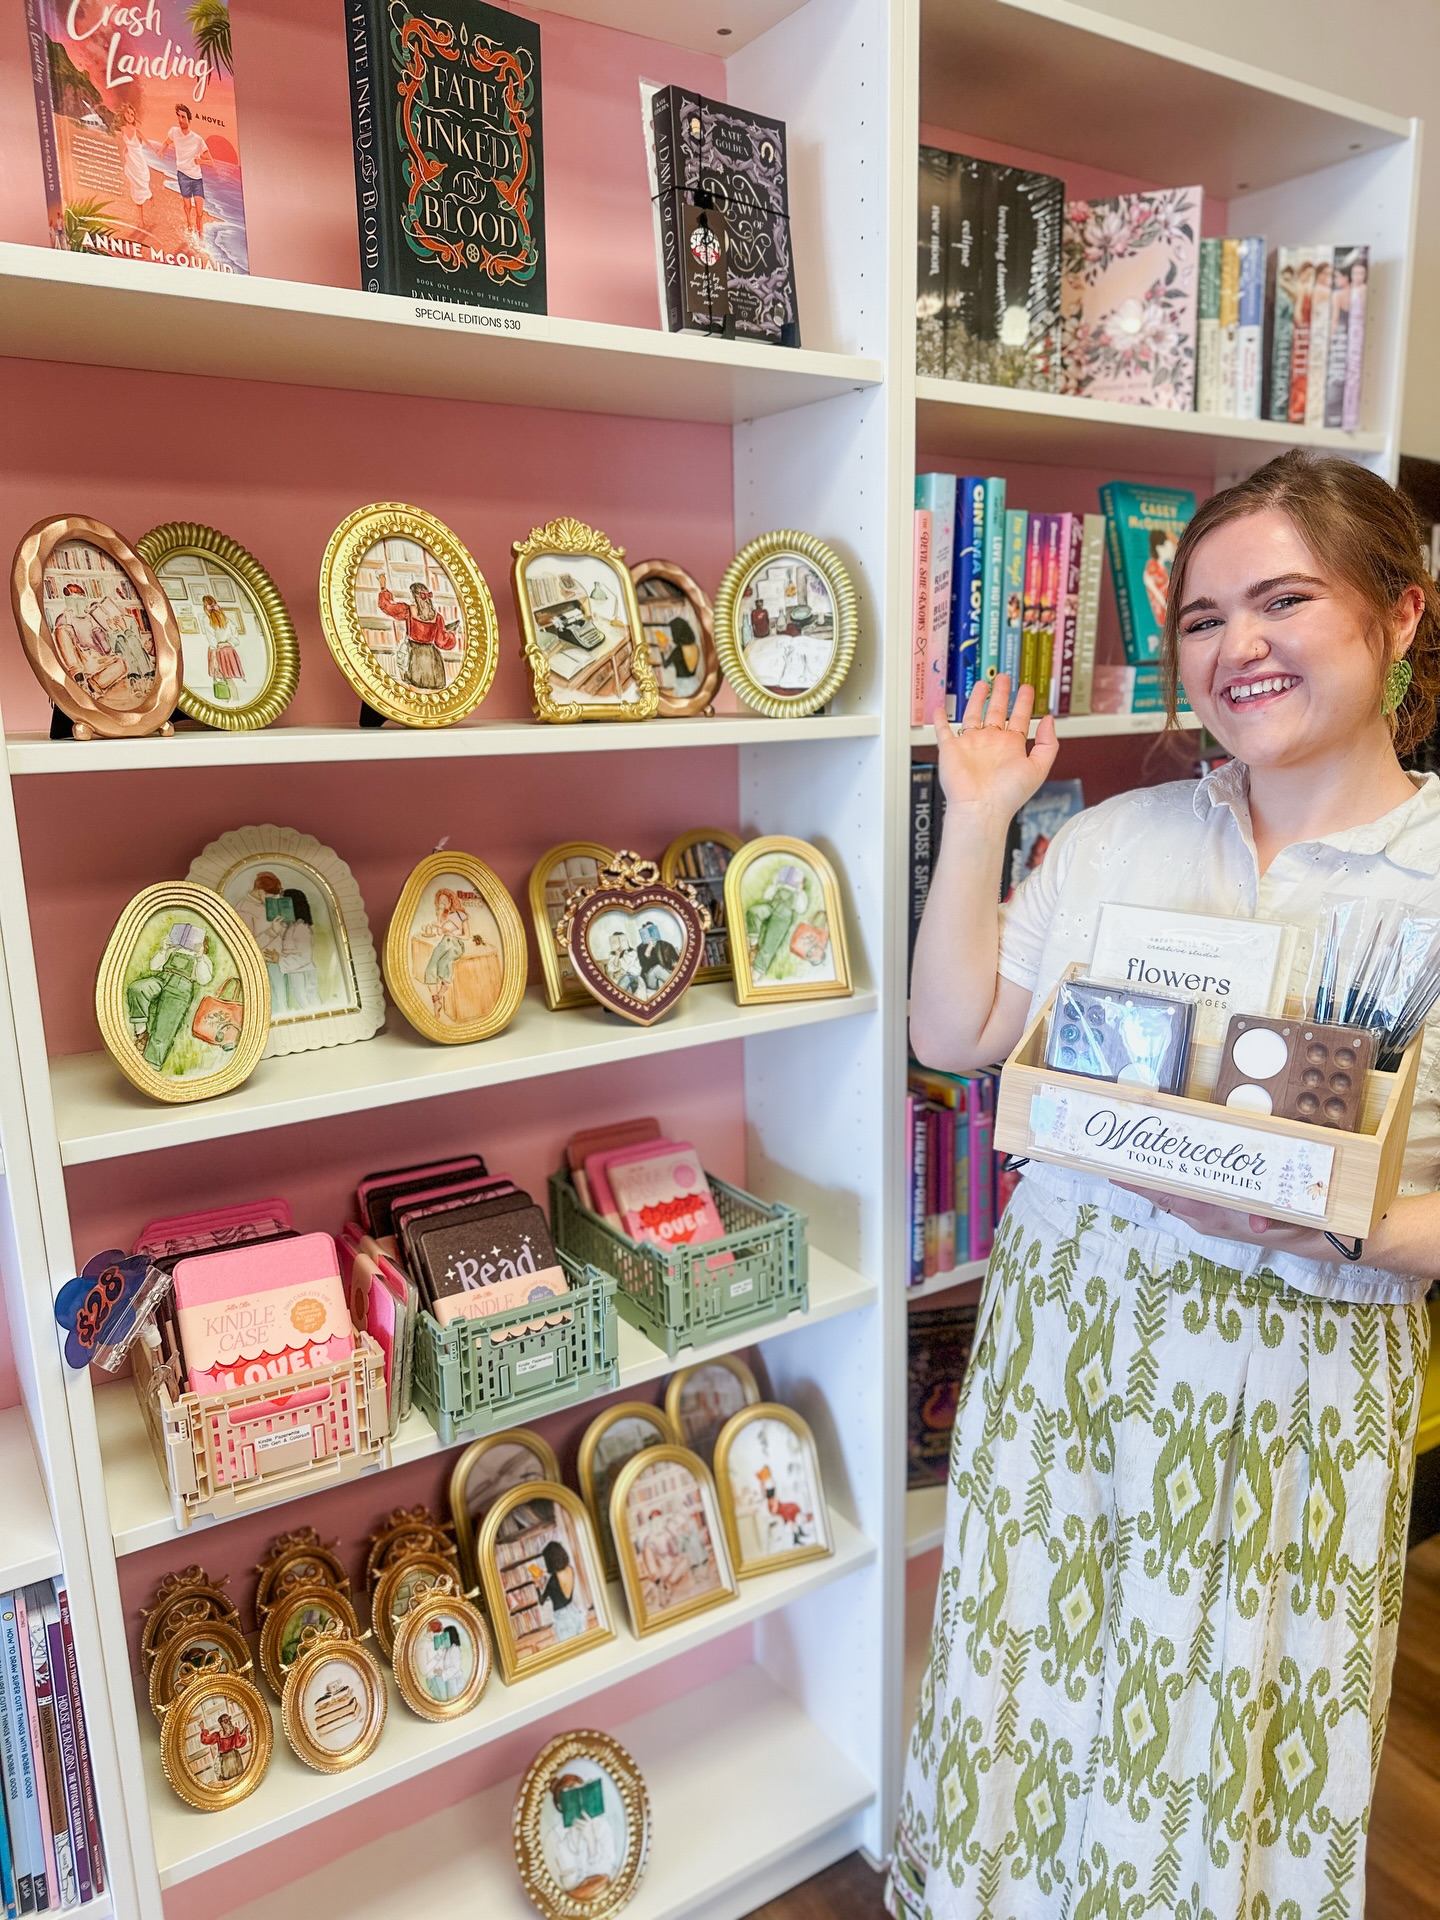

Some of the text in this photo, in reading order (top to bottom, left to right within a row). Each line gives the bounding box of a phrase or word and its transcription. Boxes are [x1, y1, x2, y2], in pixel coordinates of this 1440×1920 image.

[66, 0, 162, 41] Crash
[352, 13, 369, 73] FATE
[460, 49, 470, 68] A
[106, 32, 214, 102] Landing
[434, 65, 499, 120] FATE
[202, 116, 226, 128] NOVEL
[356, 76, 373, 150] INKED
[426, 115, 510, 170] INKED
[716, 138, 750, 157] GOLDEN
[720, 128, 743, 142] KATE
[462, 176, 478, 198] IN
[702, 174, 769, 222] DAWN
[362, 190, 379, 269] BLOOD
[424, 194, 518, 248] BLOOD
[664, 206, 672, 227] OF
[995, 205, 1010, 261] breaking
[82, 232, 144, 258] ANNIE
[664, 231, 677, 288] ONYX
[951, 220, 973, 267] eclipse
[416, 278, 434, 287] BOOK
[438, 283, 450, 291] ONE
[415, 308, 521, 330] SPECIAL EDITIONS $30
[1294, 328, 1309, 377] ELITE
[1140, 502, 1177, 518] CASEY
[972, 484, 986, 574] CINEMA
[920, 531, 929, 565] DEVIL
[992, 536, 1003, 564] LOVE
[919, 566, 928, 590] SHE
[934, 570, 950, 585] RUBY
[918, 591, 926, 632] KNOWS
[970, 579, 982, 636] LOVE
[990, 586, 1000, 606] HOT
[1082, 536, 1101, 674] A LITTLE LIFE
[989, 608, 1000, 656] CHICKEN
[1064, 620, 1073, 660] LYLA
[1061, 666, 1071, 693] LEE
[915, 803, 930, 860] HOUSE
[1147, 944, 1221, 959] creative studio
[1126, 958, 1231, 996] flowers
[1084, 1110, 1267, 1176] Watercolor
[1126, 1150, 1262, 1191] TOOLS & SUPPLIES
[648, 1209, 708, 1244] LOVER
[454, 1244, 536, 1292] Read
[77, 1266, 125, 1349] $28
[206, 1305, 276, 1337] KINDLE
[457, 1293, 515, 1320] KINDLE
[220, 1325, 270, 1352] CASE
[224, 1344, 333, 1391] LOVER
[274, 1430, 300, 1440] Paperwhite
[9, 1646, 16, 1655] TO
[10, 1656, 18, 1674] DRAW
[12, 1676, 22, 1696] SUPER
[67, 1642, 88, 1760] TRAVELS THROUGH THE WIZARDING WORLD
[14, 1696, 23, 1711] CUTE
[1, 1714, 11, 1736] THINGS
[18, 1713, 27, 1736] THINGS
[42, 1706, 54, 1753] FOURTH WING
[58, 1694, 75, 1770] HOUSE DRAGON
[4, 1736, 14, 1754] WITH
[20, 1736, 30, 1752] WITH
[6, 1755, 16, 1776] BOBBIE
[22, 1754, 32, 1775] BOBBIE
[9, 1778, 18, 1800] GOODS
[24, 1776, 34, 1799] GOODS
[68, 1772, 84, 1850] THE OFFICIAL COLORING BOOK
